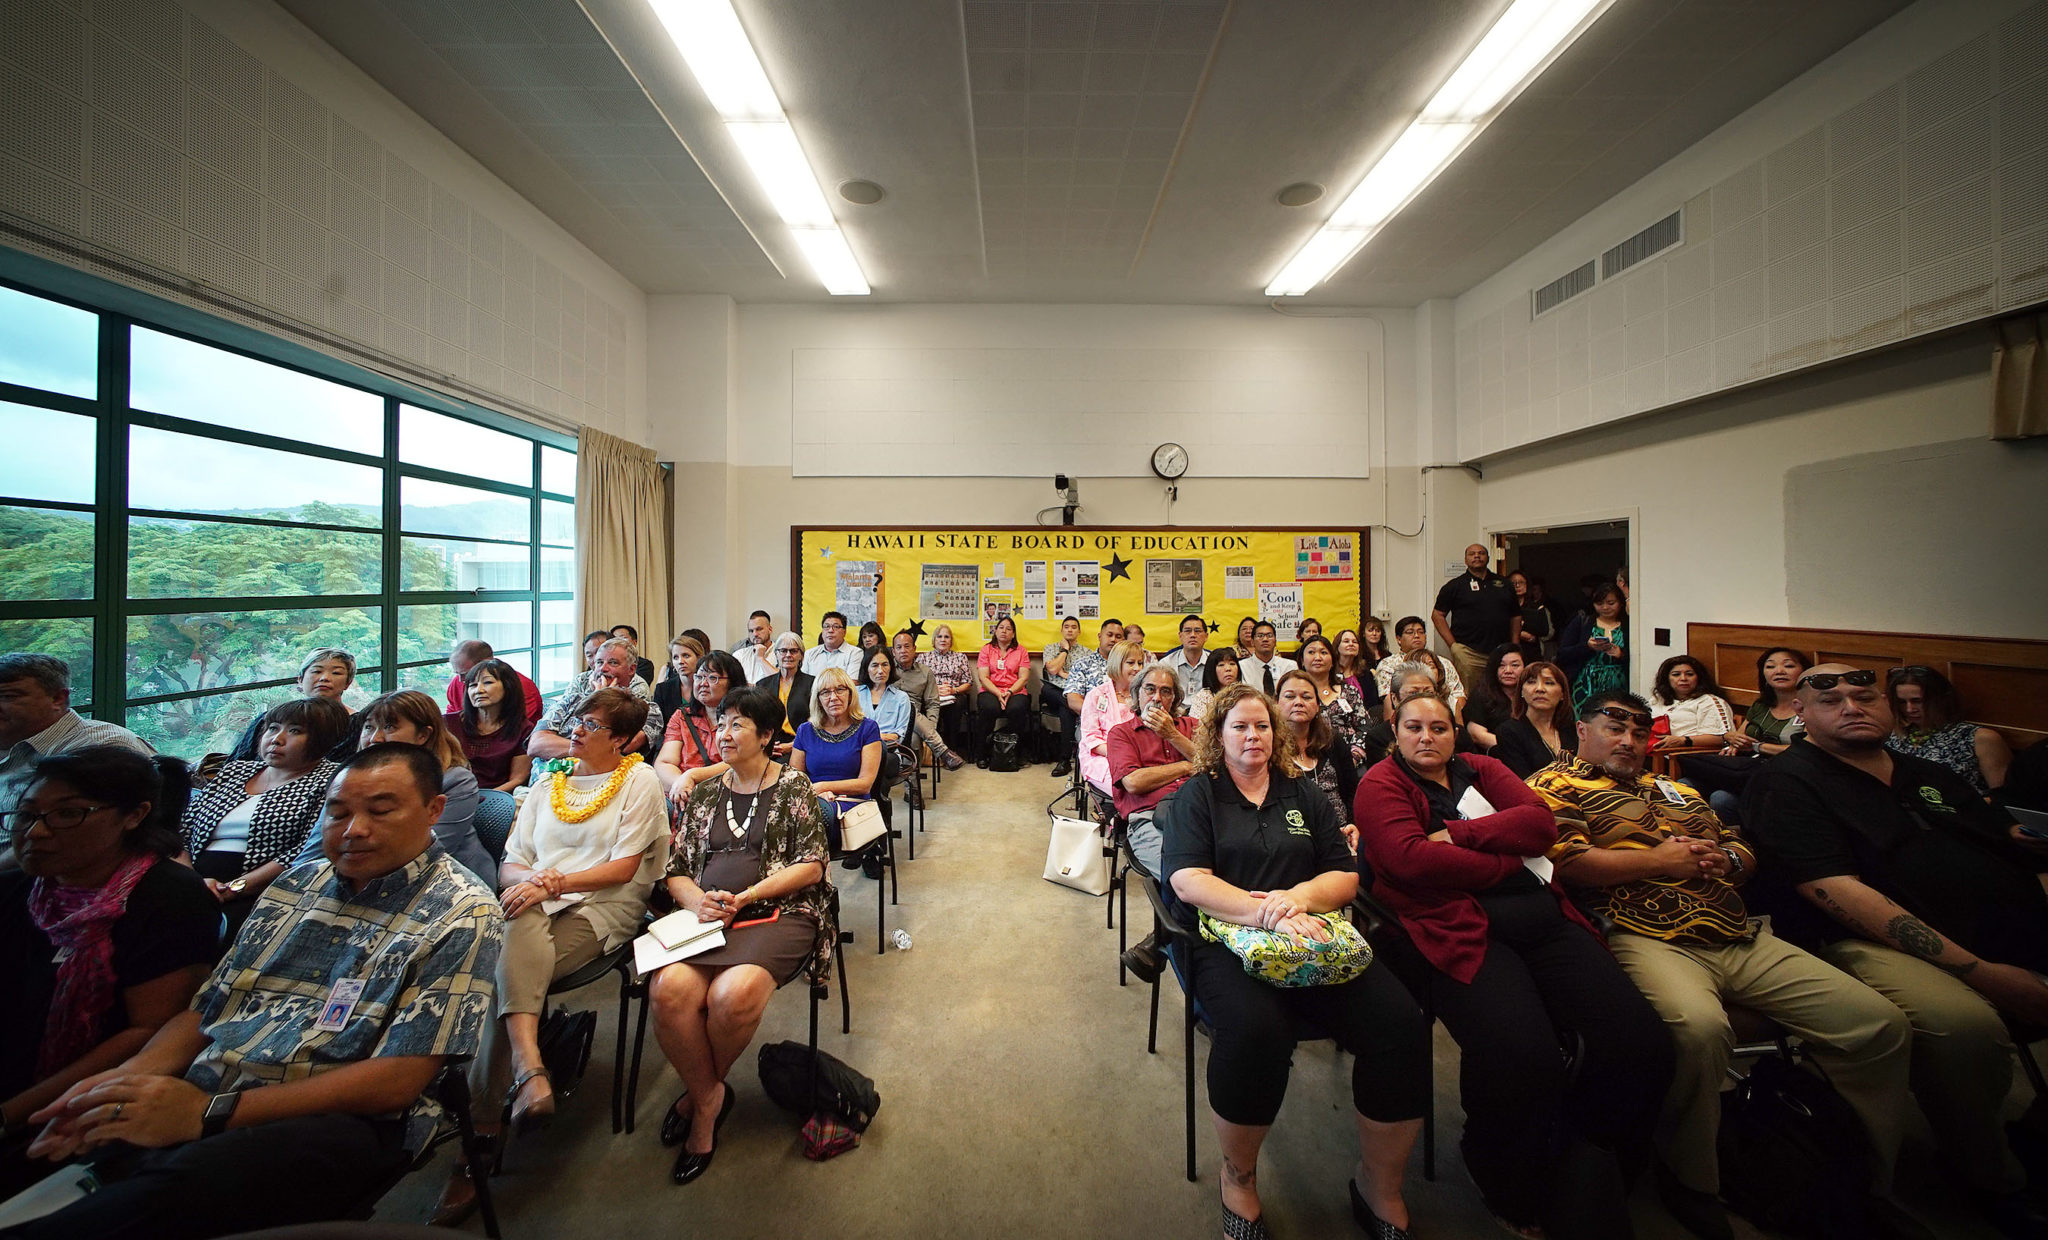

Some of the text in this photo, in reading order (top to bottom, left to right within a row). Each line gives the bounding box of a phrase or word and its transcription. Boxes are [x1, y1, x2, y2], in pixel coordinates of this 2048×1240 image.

[847, 534, 1249, 550] HAWAII STATE BOARD OF EDUCATION
[1301, 537, 1351, 550] Live Aloha
[1267, 591, 1296, 603] Cool
[1271, 619, 1292, 629] Safe
